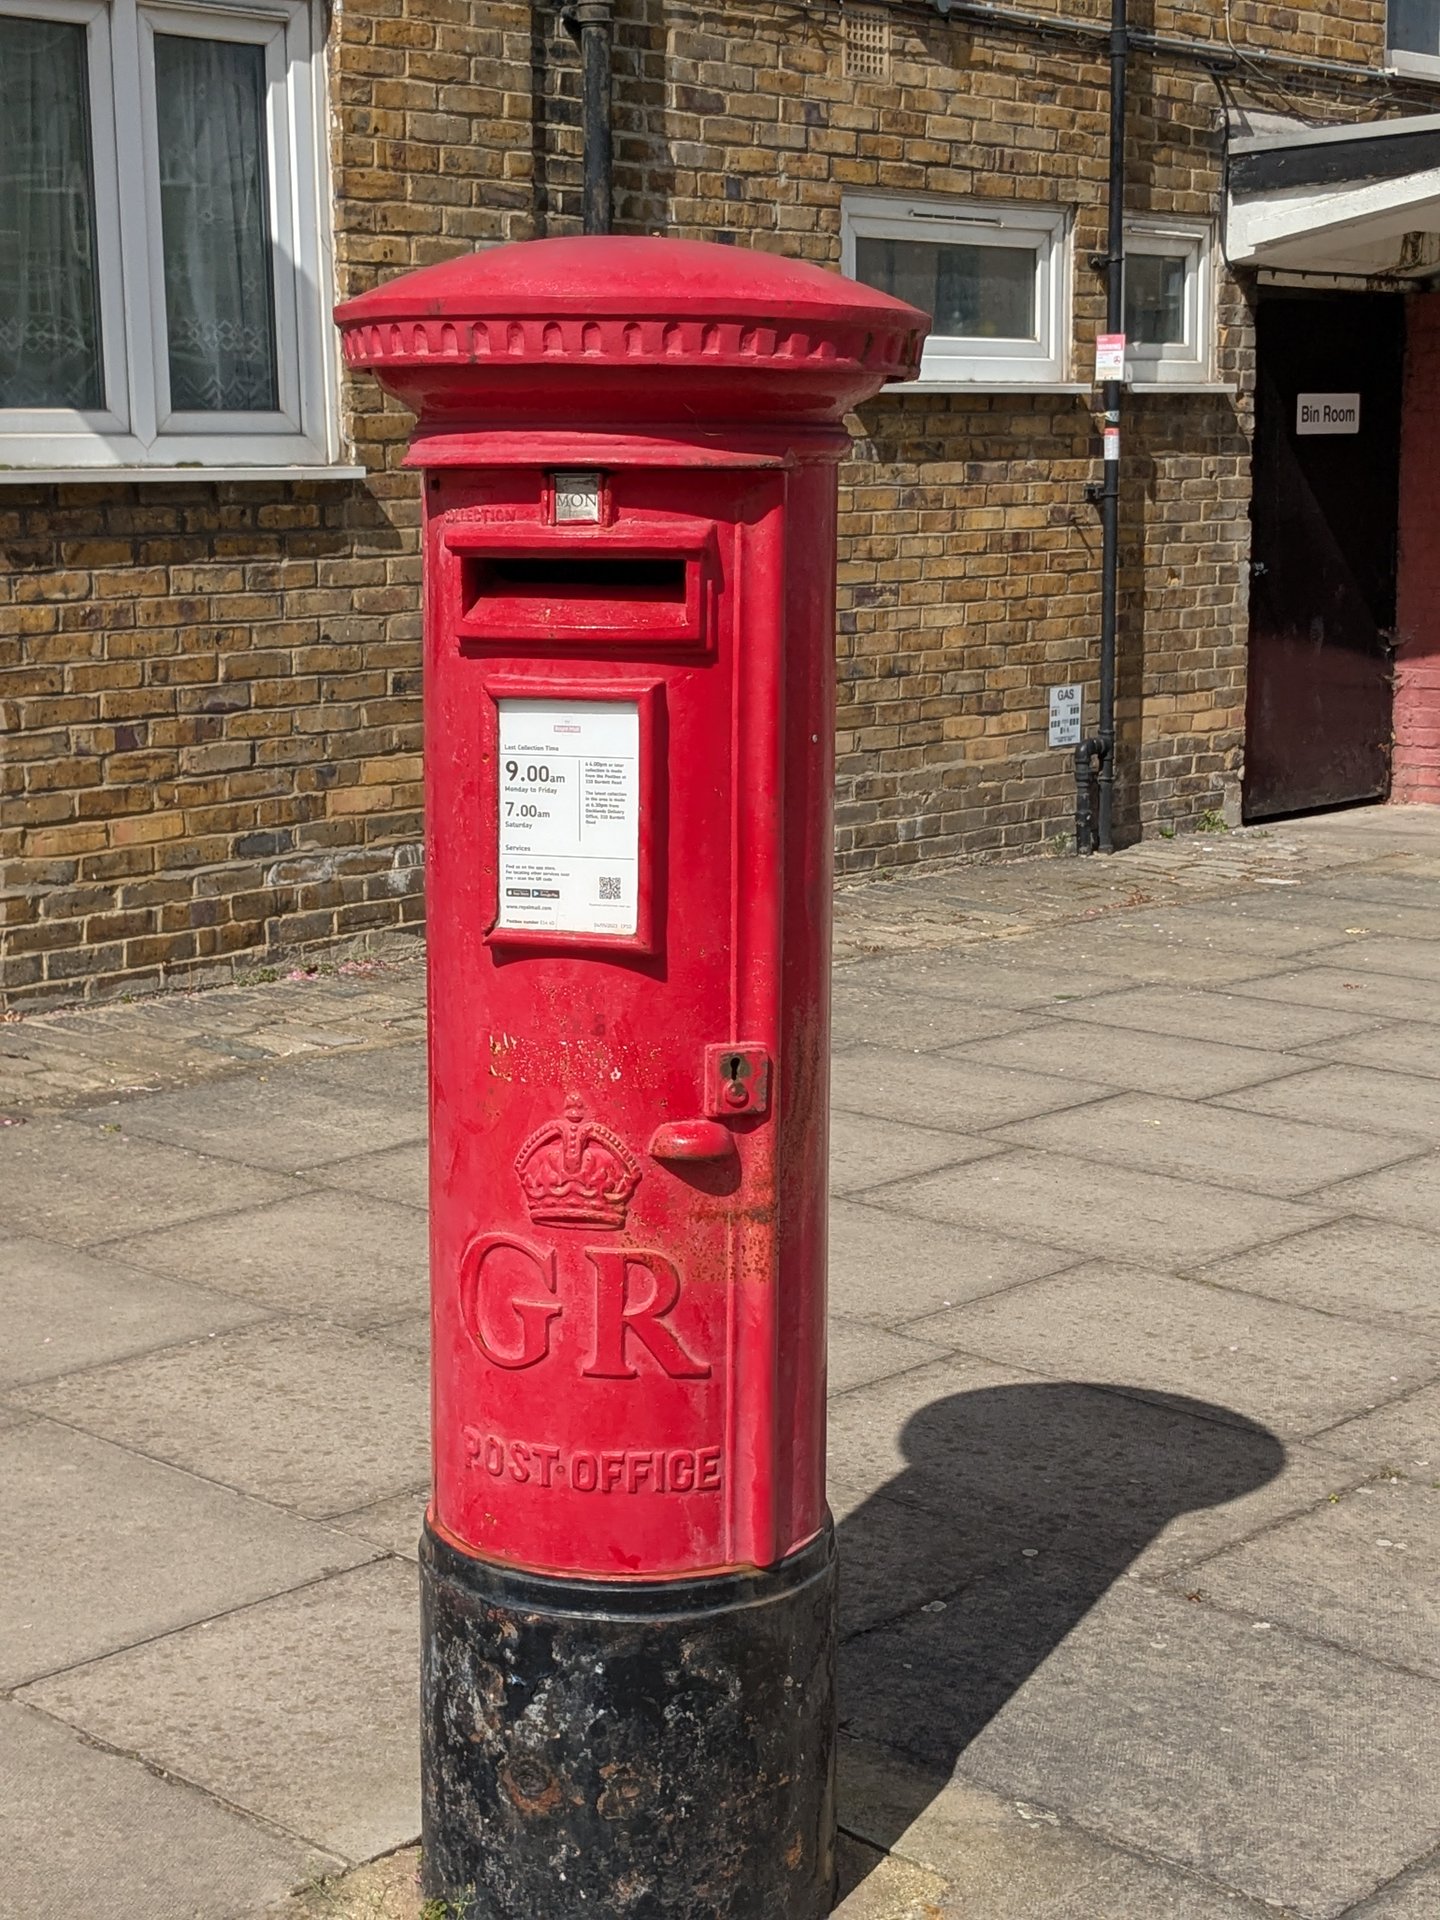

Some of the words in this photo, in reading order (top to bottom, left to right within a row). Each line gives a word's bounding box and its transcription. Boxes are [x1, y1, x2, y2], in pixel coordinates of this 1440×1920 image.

[1301, 405, 1320, 422] Bin
[1323, 404, 1356, 422] Room
[557, 494, 597, 508] MON
[1058, 689, 1074, 700] GAS
[505, 760, 566, 783] 9.00am
[504, 786, 528, 794] Monday
[538, 787, 557, 795] Friday
[505, 802, 550, 818] 7.00am
[505, 820, 532, 830] Saturday
